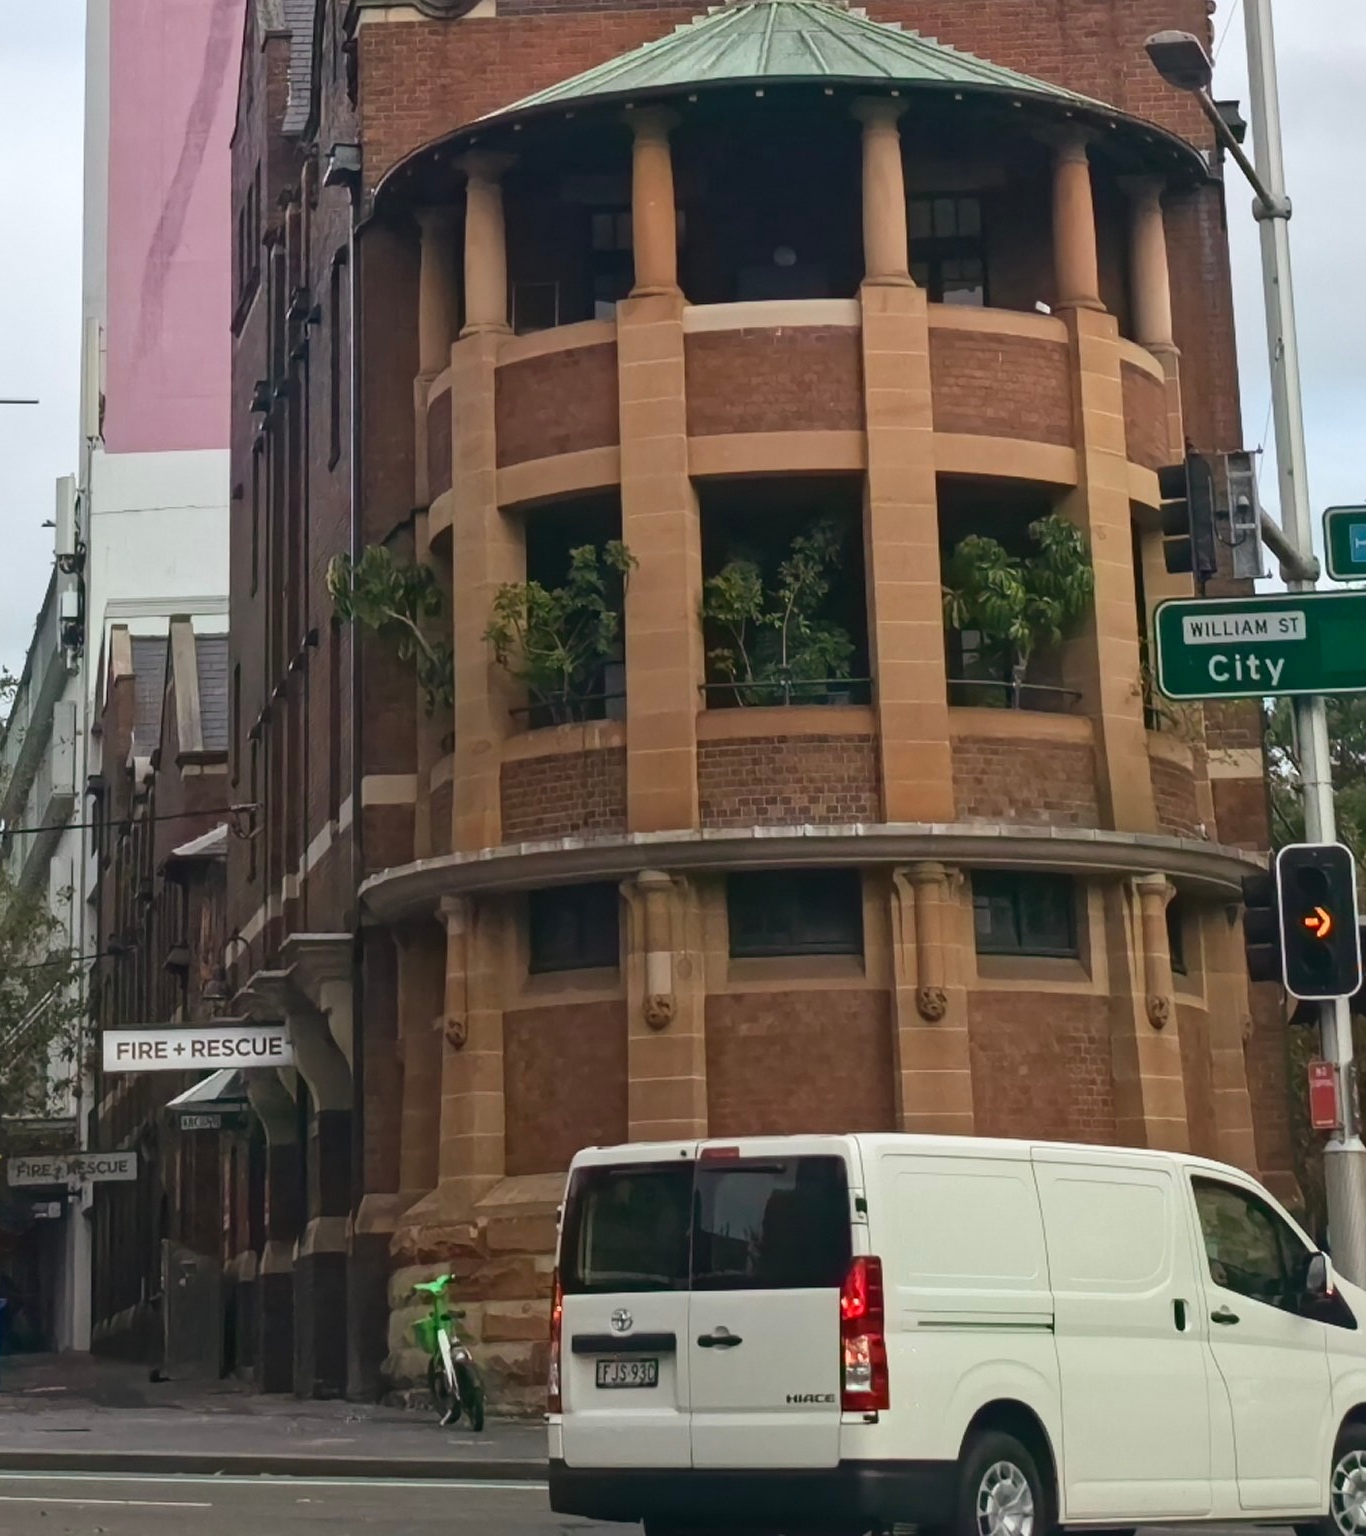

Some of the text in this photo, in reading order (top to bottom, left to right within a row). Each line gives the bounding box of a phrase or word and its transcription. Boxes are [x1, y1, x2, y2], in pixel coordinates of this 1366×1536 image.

[1190, 617, 1298, 638] WILLIAM ST
[1208, 654, 1285, 686] City
[116, 1041, 168, 1061] FIRE
[191, 1036, 283, 1059] RESCUE
[16, 1162, 52, 1178] FIRE
[786, 1394, 835, 1404] HIACE
